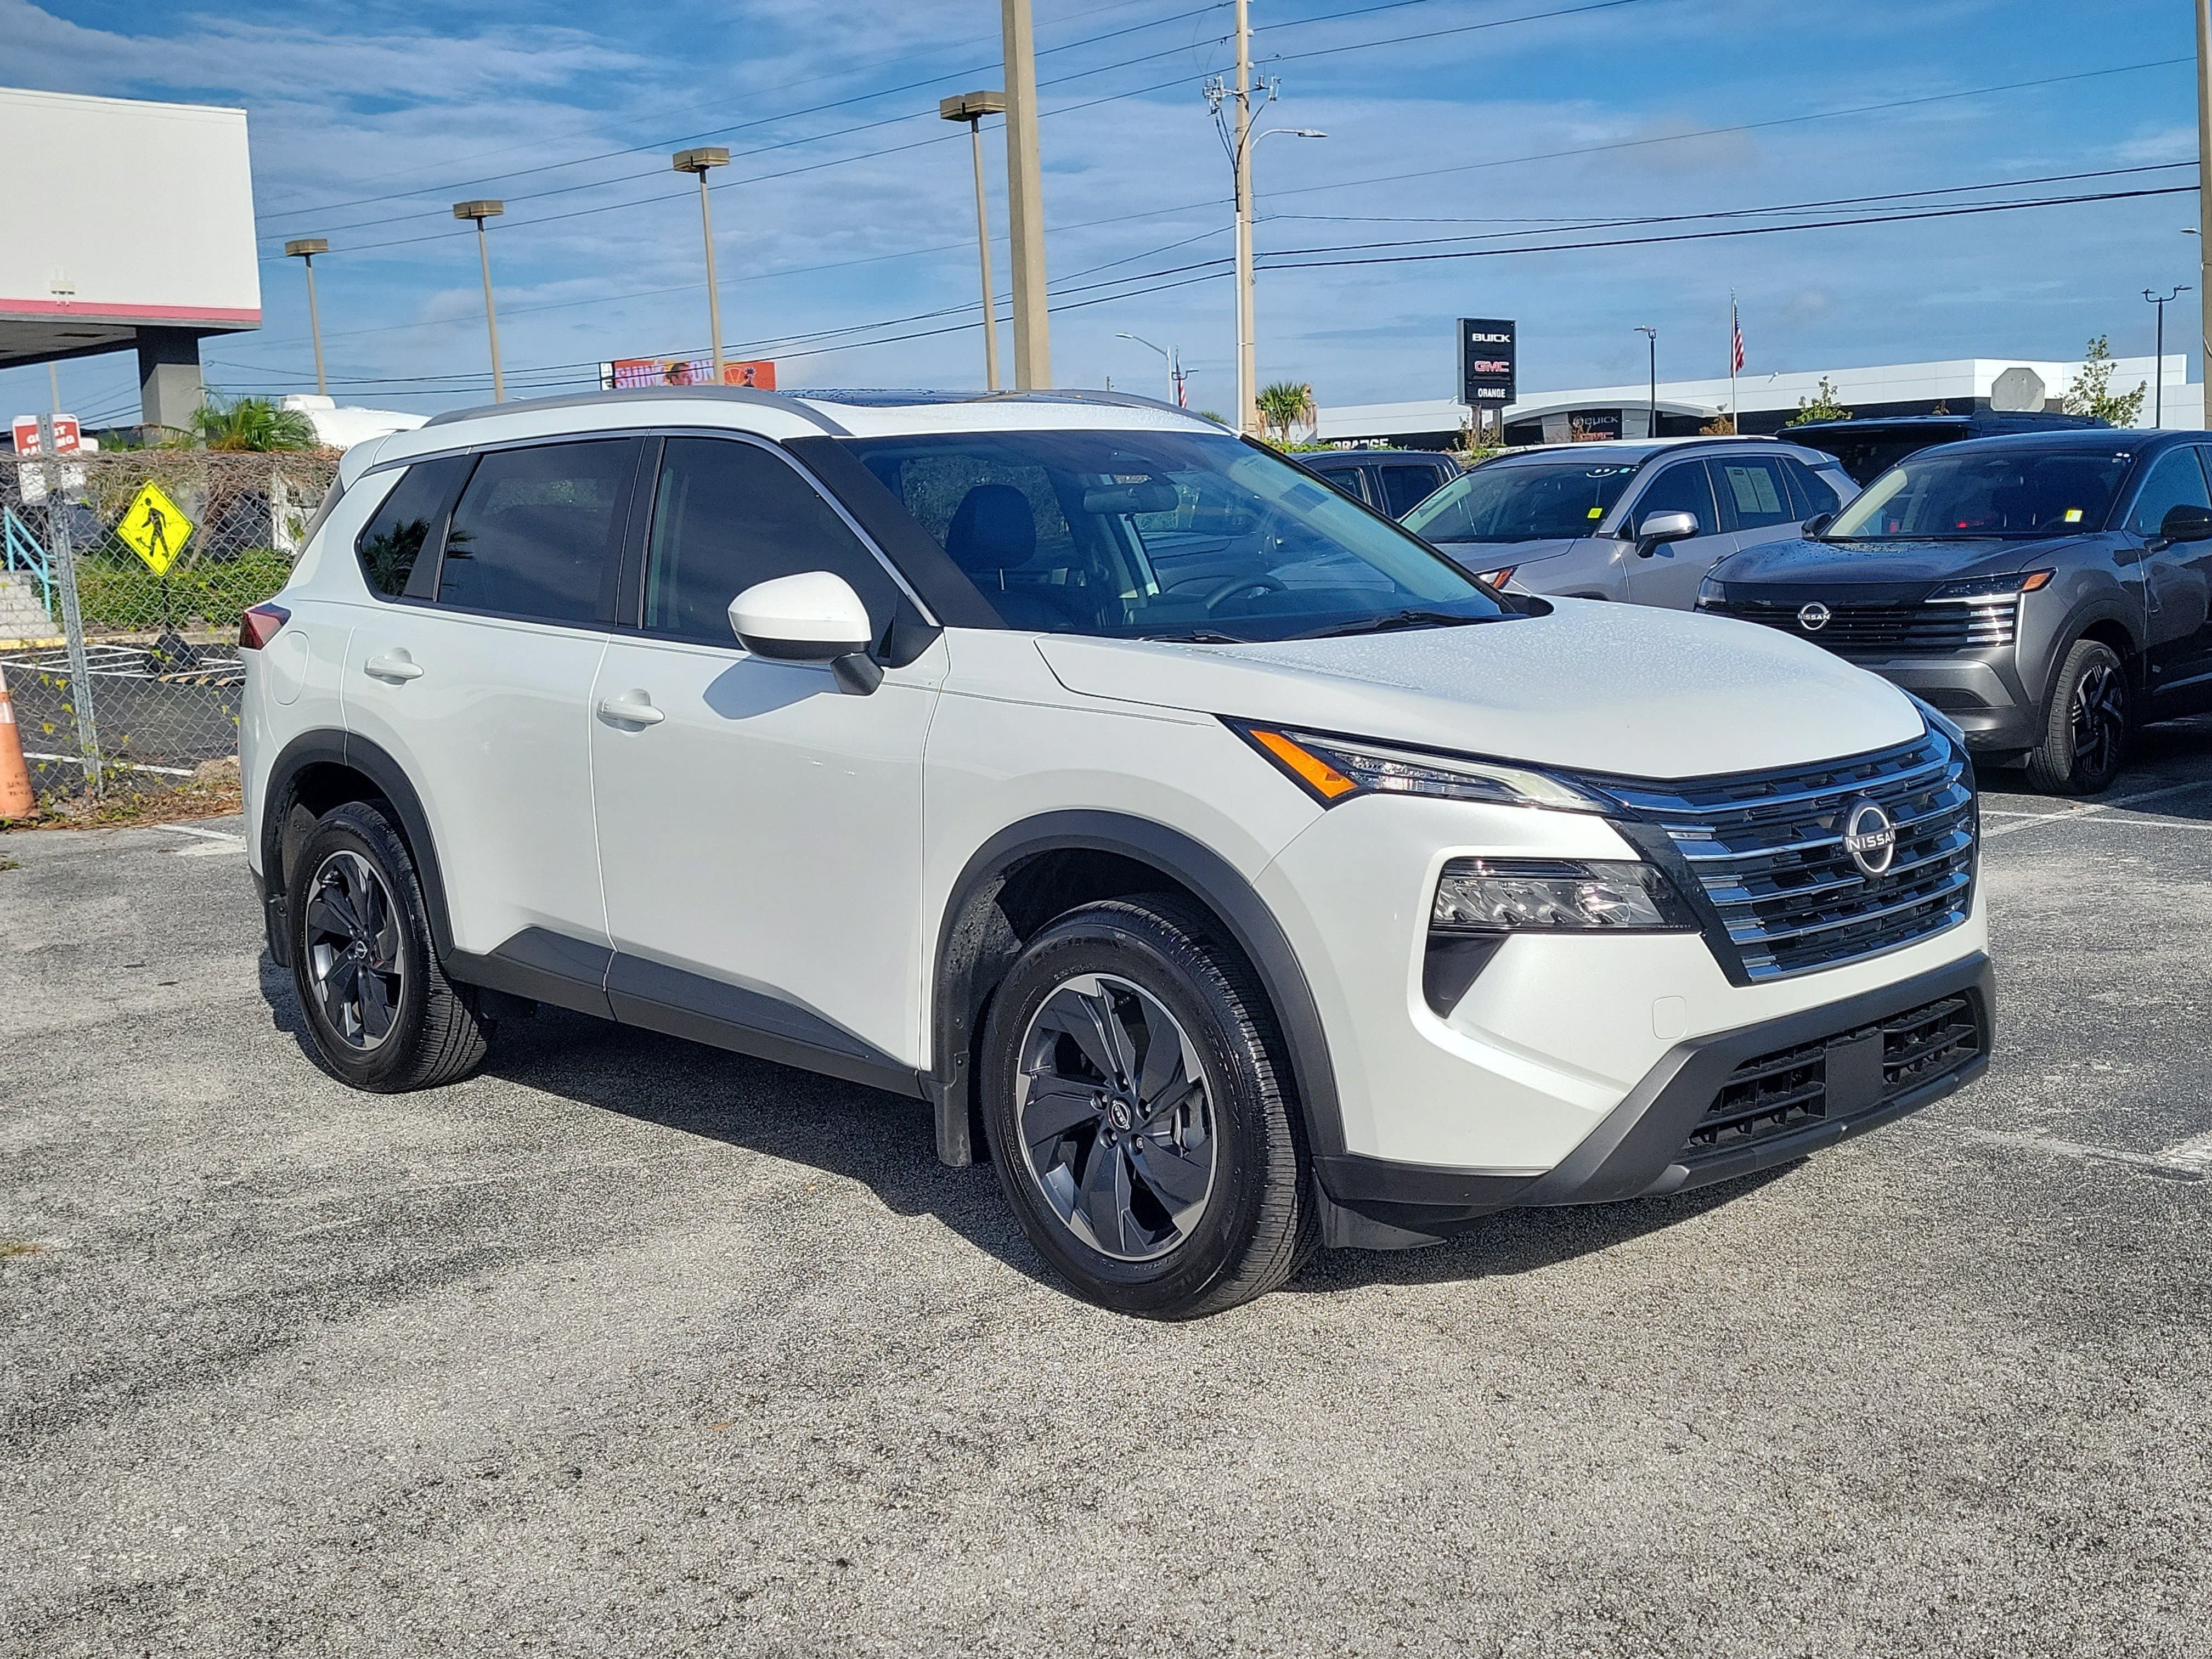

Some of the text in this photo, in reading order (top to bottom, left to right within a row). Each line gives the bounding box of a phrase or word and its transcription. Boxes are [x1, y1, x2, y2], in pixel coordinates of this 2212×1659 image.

[1472, 333, 1511, 342] BUICK
[1475, 360, 1509, 372] GMC
[1477, 388, 1506, 398] ORANGE
[1584, 416, 1619, 425] BUICK
[26, 425, 67, 444] GUST
[1846, 828, 1895, 851] NISSAN
